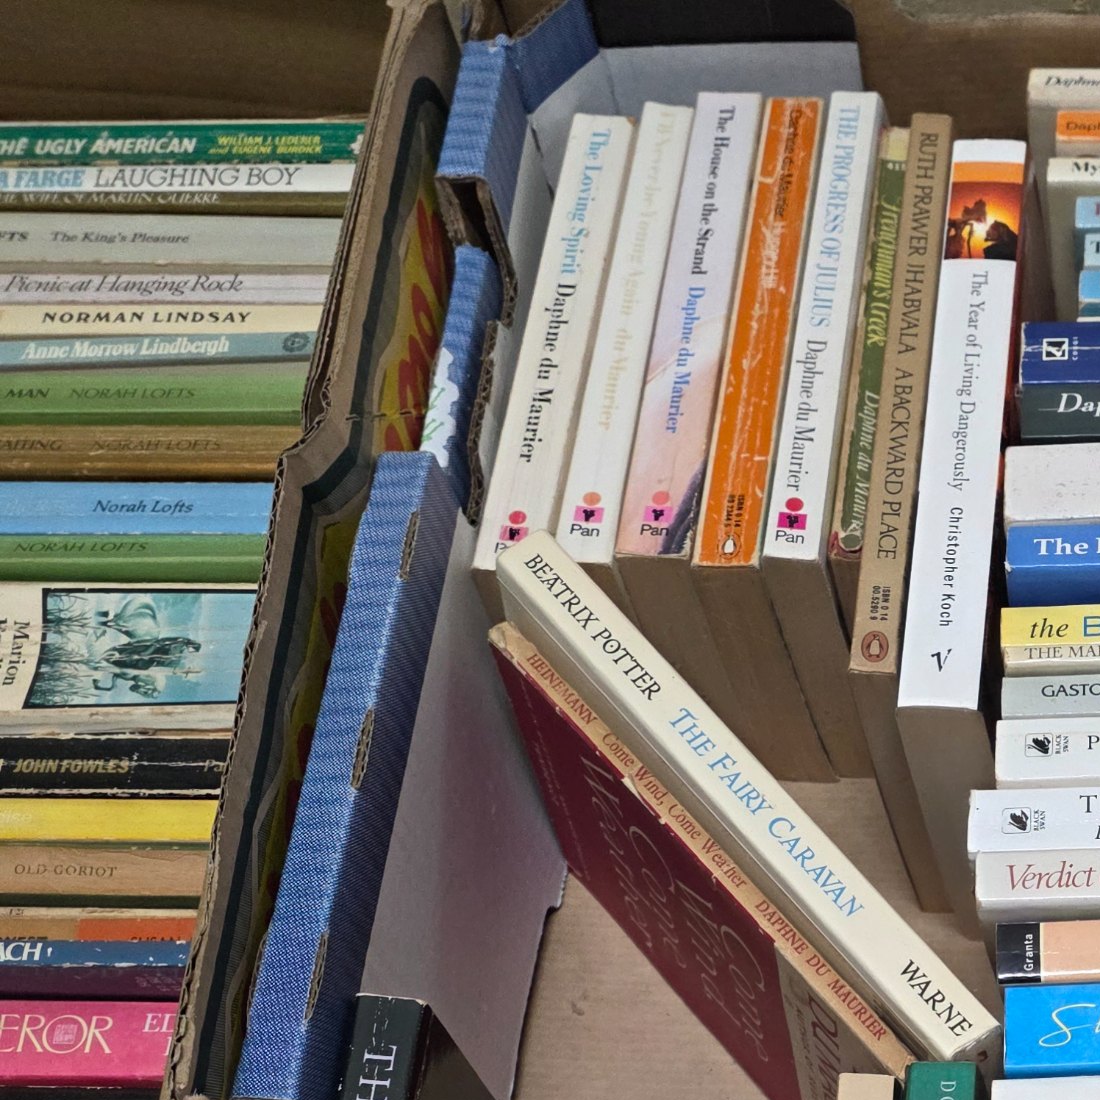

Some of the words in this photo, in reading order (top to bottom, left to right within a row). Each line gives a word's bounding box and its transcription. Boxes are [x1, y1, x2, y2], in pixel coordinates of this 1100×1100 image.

[35, 138, 86, 156] UGLY
[90, 136, 197, 154] AMERICAN
[94, 167, 240, 188] LAUGHING
[245, 167, 302, 186] BOY
[50, 231, 78, 243] The
[82, 231, 127, 244] King's
[131, 232, 190, 244] Pleasure
[4, 275, 67, 292] Picnic
[96, 275, 188, 296] Hanging
[191, 275, 243, 292] Rock
[971, 271, 988, 296] The
[42, 312, 144, 323] NORMAN
[153, 312, 252, 323] LINDSAY
[967, 301, 987, 330] Year
[21, 343, 69, 359] Anne
[73, 342, 138, 358] Morrow
[140, 337, 230, 356] Lindbergh
[966, 334, 980, 350] of
[956, 352, 980, 396] Living
[947, 401, 977, 491] Dangerously
[93, 500, 147, 514] Norah
[152, 500, 194, 514] Lofts
[775, 530, 804, 544] Pan
[942, 507, 963, 588] Christopher
[1033, 538, 1089, 555] The
[939, 594, 956, 627] Koch
[1030, 617, 1069, 639] the
[2, 619, 31, 686] Marion
[13, 758, 59, 773] JOHN
[60, 758, 130, 773] FOWLES
[524, 553, 600, 630] BEATRIX
[592, 627, 662, 701] POTTER
[669, 707, 716, 757] THE
[707, 752, 774, 816] FAIRY
[768, 817, 865, 918] CARAVAN
[900, 959, 974, 1037] WARNE
[1024, 933, 1034, 971] Granta
